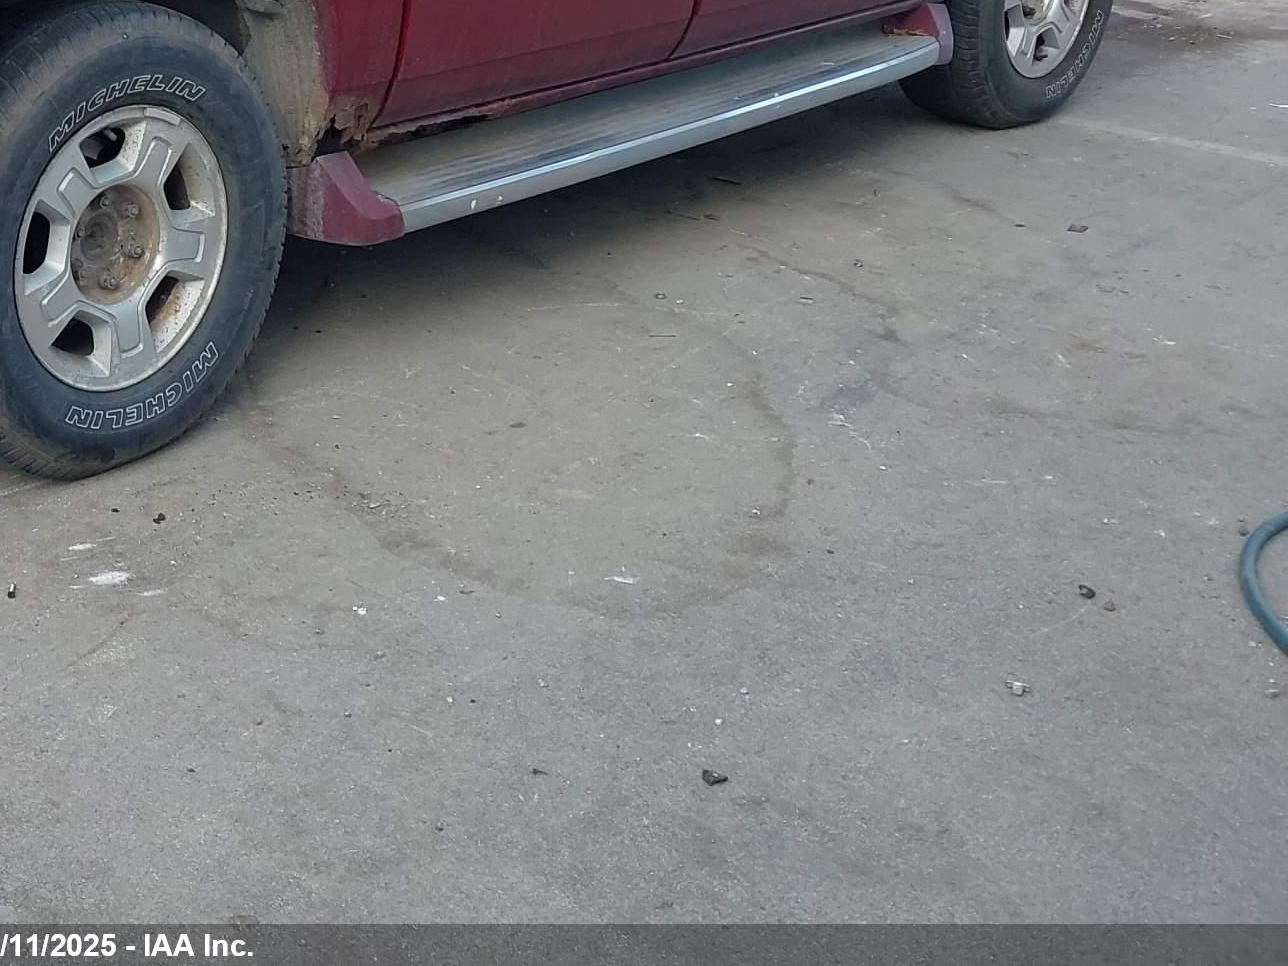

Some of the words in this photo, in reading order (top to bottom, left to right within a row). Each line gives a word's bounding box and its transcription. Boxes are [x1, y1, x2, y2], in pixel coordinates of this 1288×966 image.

[1045, 9, 1105, 99] MICHELIN
[48, 74, 206, 153] MICHELIN
[65, 341, 220, 430] MICHELIN
